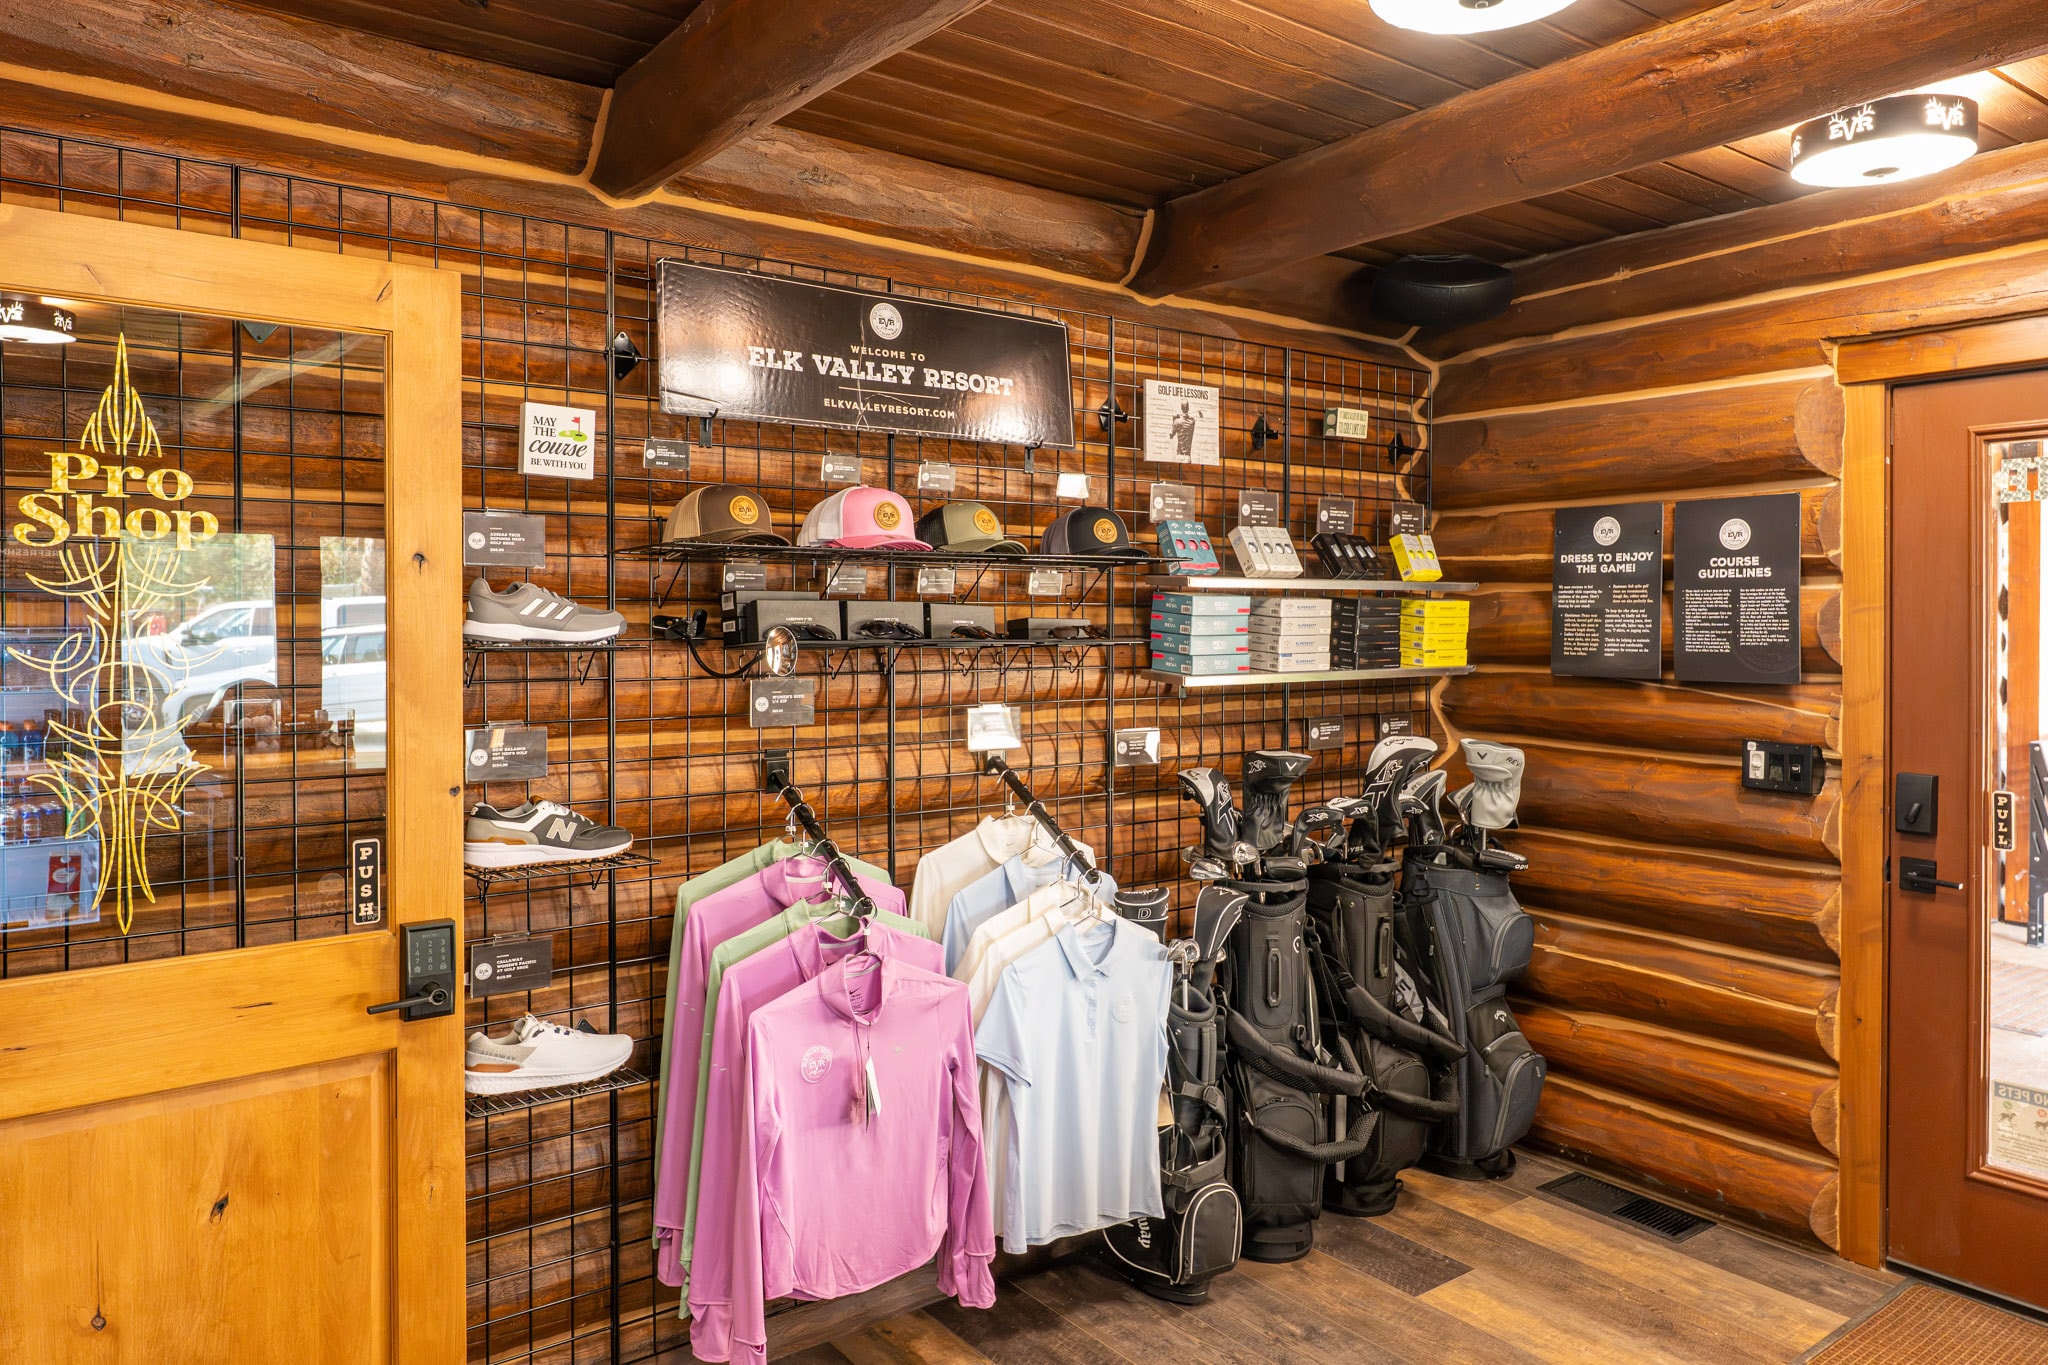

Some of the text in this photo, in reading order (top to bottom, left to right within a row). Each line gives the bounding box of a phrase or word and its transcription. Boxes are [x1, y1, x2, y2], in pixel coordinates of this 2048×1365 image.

[1829, 110, 1874, 140] EVR
[1925, 102, 1964, 130] EVR
[850, 344, 926, 362] WELCOME TO
[748, 345, 1013, 396] ELK VALLEY RESORT
[1158, 384, 1208, 400] GOLF LIFE LESSONS
[824, 397, 956, 420] ELKVALLEYRESORT.COM
[533, 416, 558, 426] MAY
[533, 426, 556, 437] THE
[529, 440, 588, 458] course
[530, 458, 587, 470] BE WITH YOU
[44, 452, 194, 500] Pro
[14, 494, 219, 552] Shop
[1560, 552, 1654, 563] DRESS TO ENJOY
[1710, 556, 1760, 567] COURSE
[1576, 564, 1636, 573] THE GAME!
[1698, 567, 1772, 579] GUIDELINES
[1997, 796, 2008, 845] PULL
[359, 847, 374, 916] PUSH
